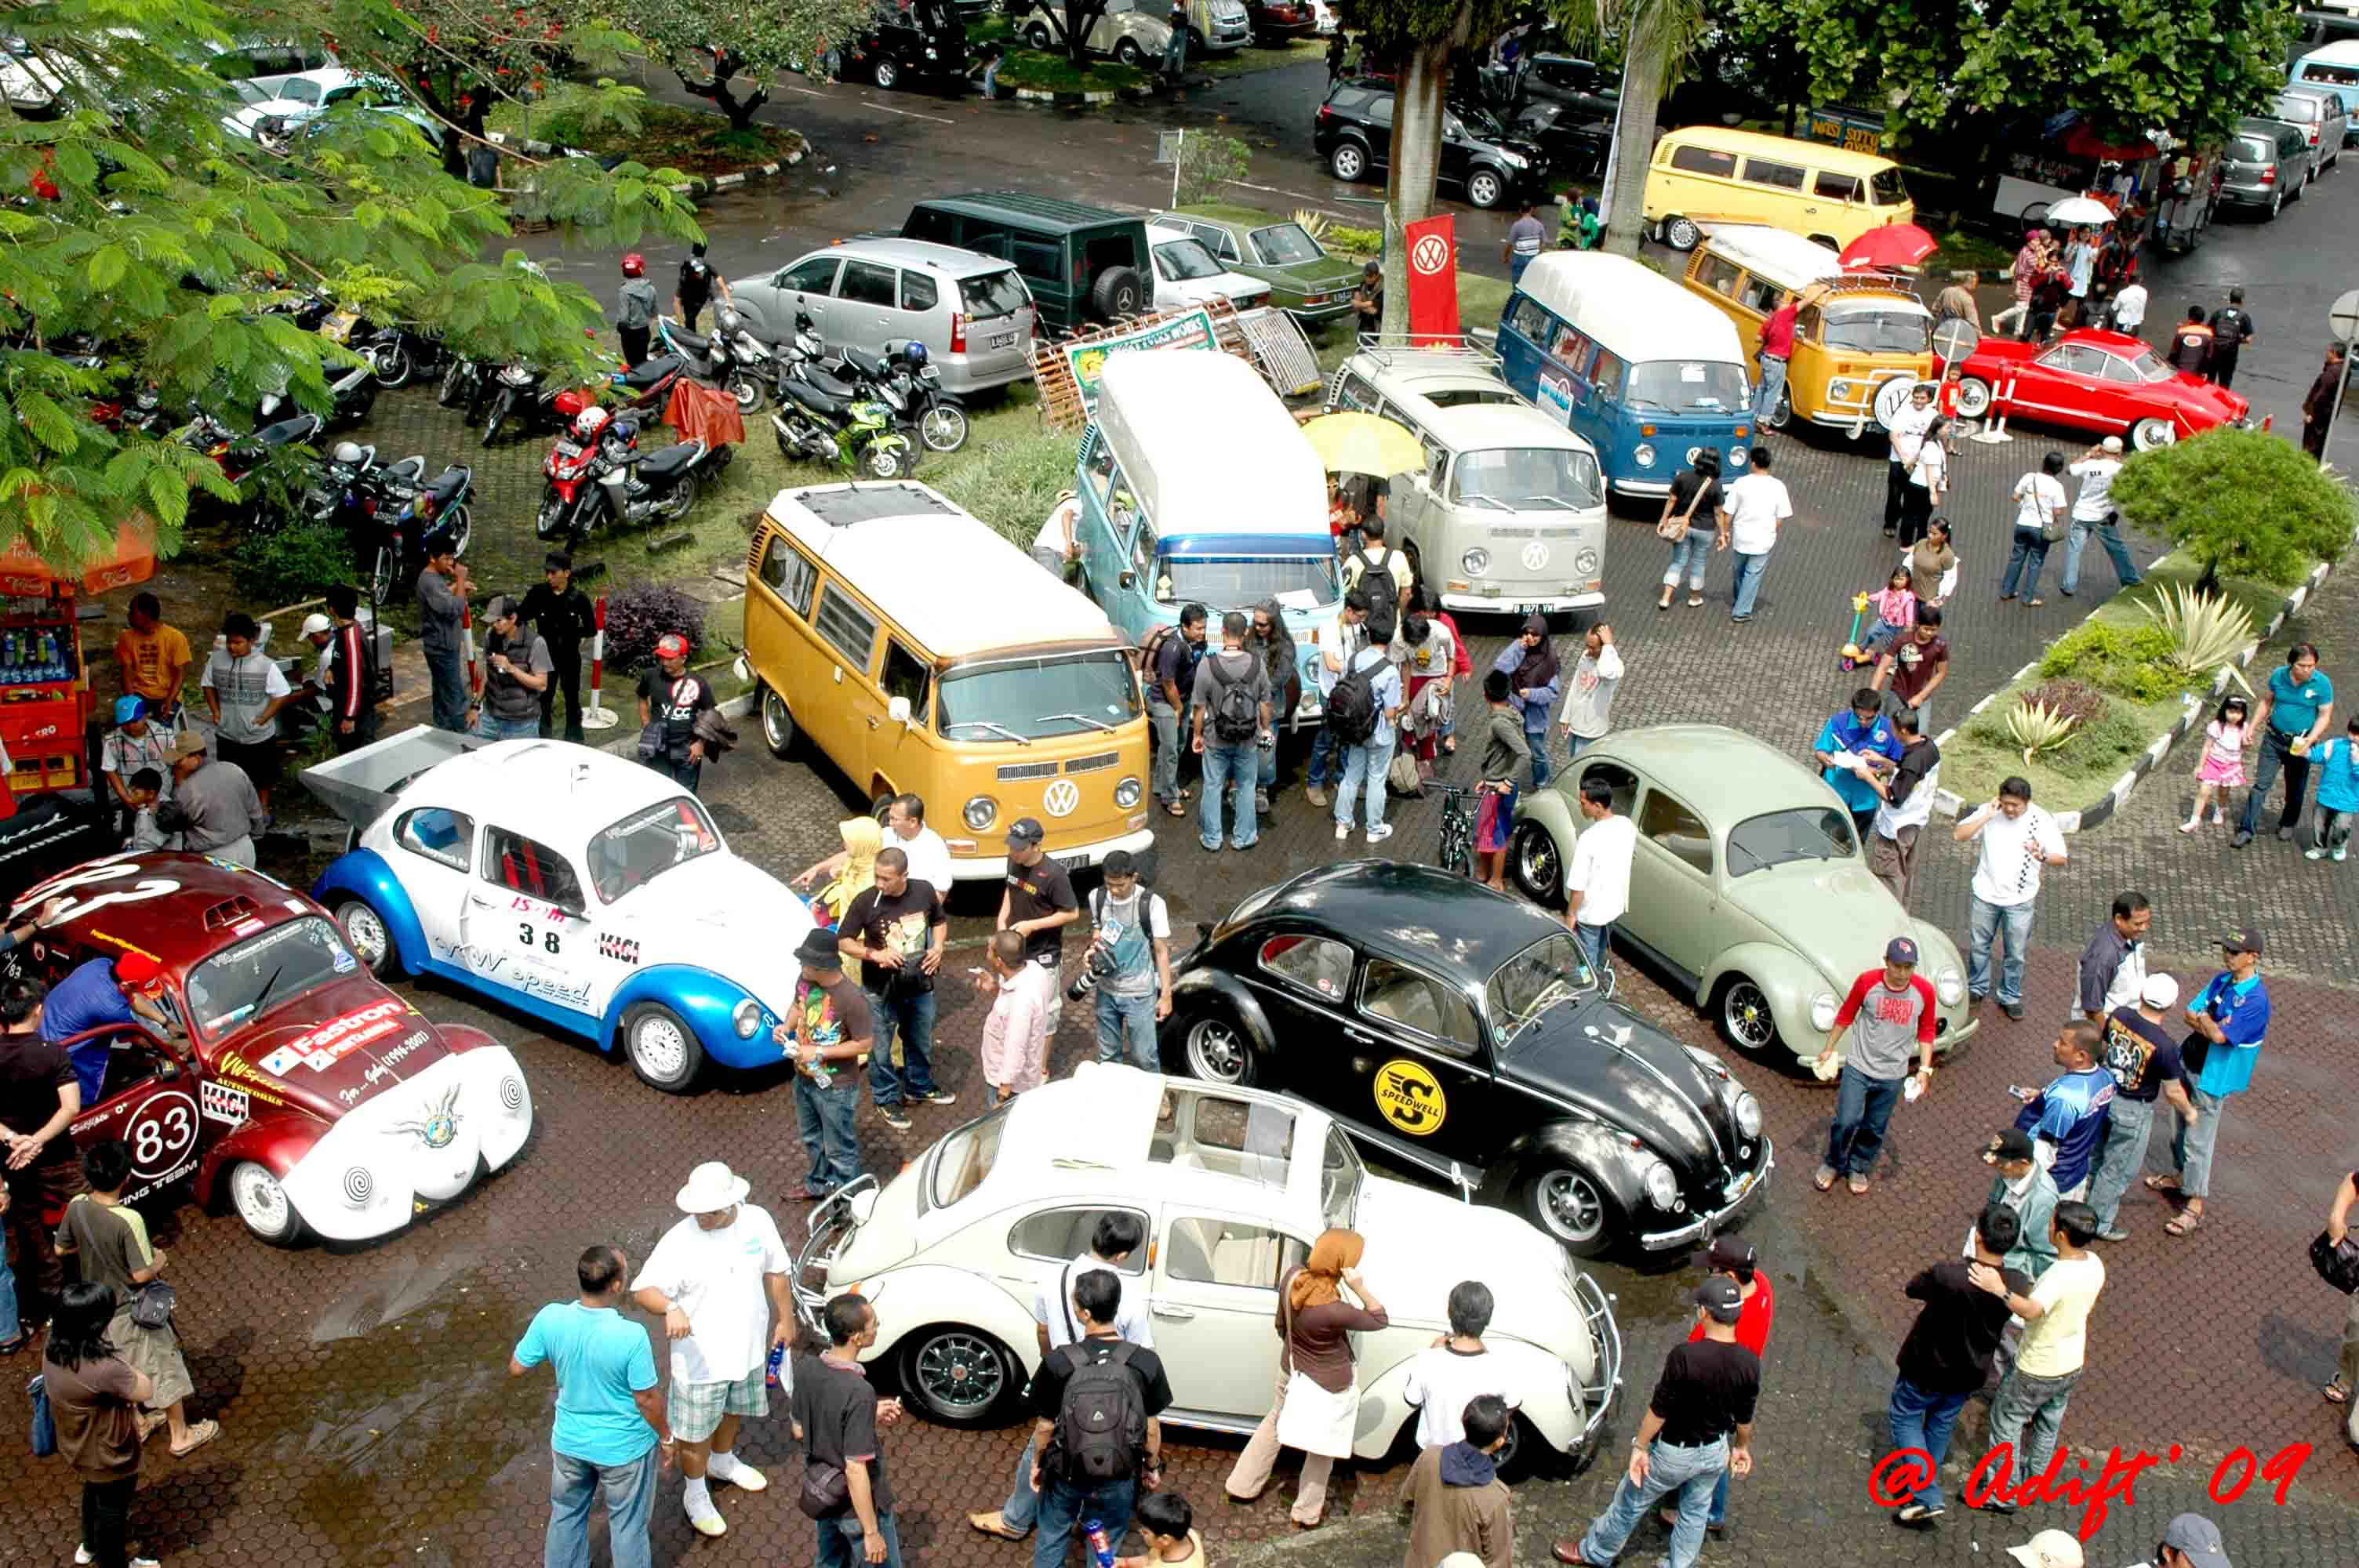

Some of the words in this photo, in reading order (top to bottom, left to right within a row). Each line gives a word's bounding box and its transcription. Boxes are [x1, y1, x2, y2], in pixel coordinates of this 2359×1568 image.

[290, 1001, 403, 1054] Fastron
[1381, 1089, 1439, 1117] SPEEDWELL
[135, 1106, 191, 1163] 83
[152, 1160, 198, 1189] TEAM
